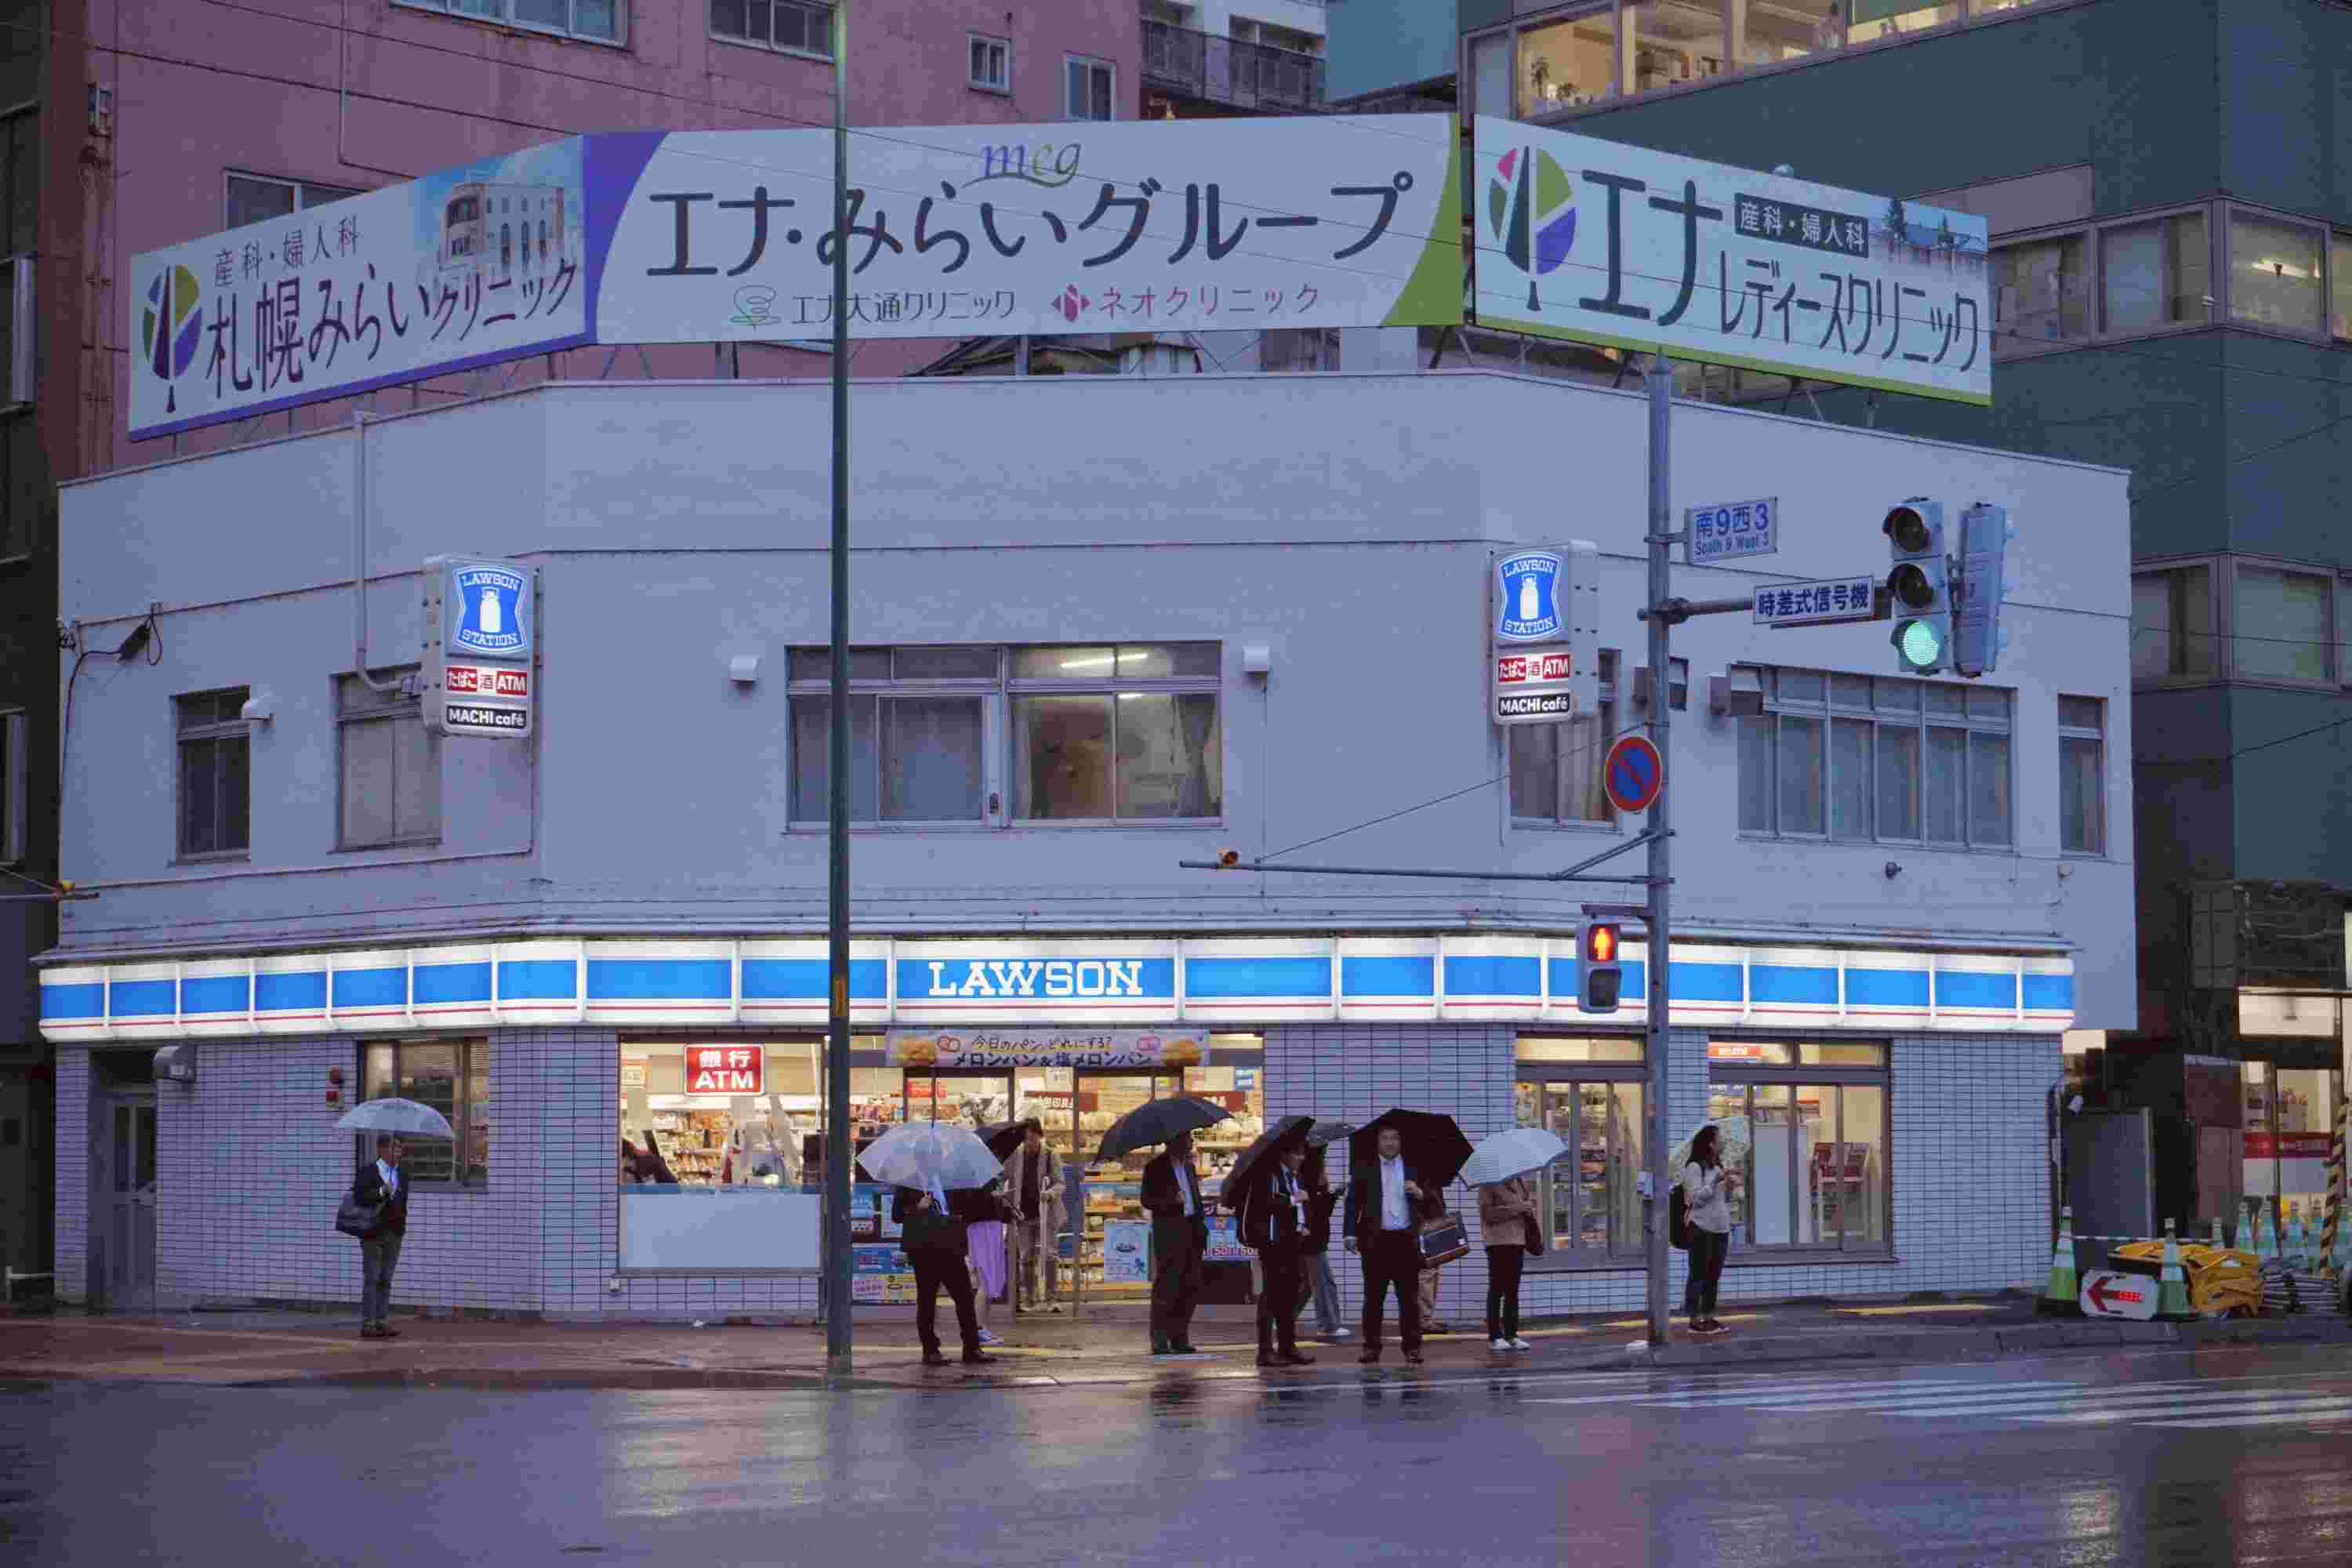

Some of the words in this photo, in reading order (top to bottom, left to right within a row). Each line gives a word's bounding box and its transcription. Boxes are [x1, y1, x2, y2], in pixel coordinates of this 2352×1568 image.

[647, 169, 1414, 278] エナ・みらいグループ
[1740, 201, 1865, 252] 産科・婦人科
[213, 214, 361, 289] 産科・婦人科
[1578, 168, 1724, 328] エナ
[790, 290, 1016, 325] エナ大通クリニック
[1098, 283, 1319, 318] ネオクリニック
[1719, 249, 1979, 372] レディースクリニック
[205, 257, 579, 400] 札幌みらいクリニック
[1695, 503, 1769, 541] 南9西3
[463, 572, 521, 591] LAWSON
[1503, 559, 1555, 578] LAWSON
[1758, 583, 1869, 617] 時差式信号機
[462, 629, 518, 647] STATION
[1504, 615, 1555, 634] STATION
[496, 674, 526, 691] ATM
[1543, 658, 1569, 675] ATM
[448, 708, 494, 724] MACHI
[1500, 698, 1541, 713] MACHI
[927, 960, 1143, 996] LAWSON
[695, 1069, 754, 1090] ATM
